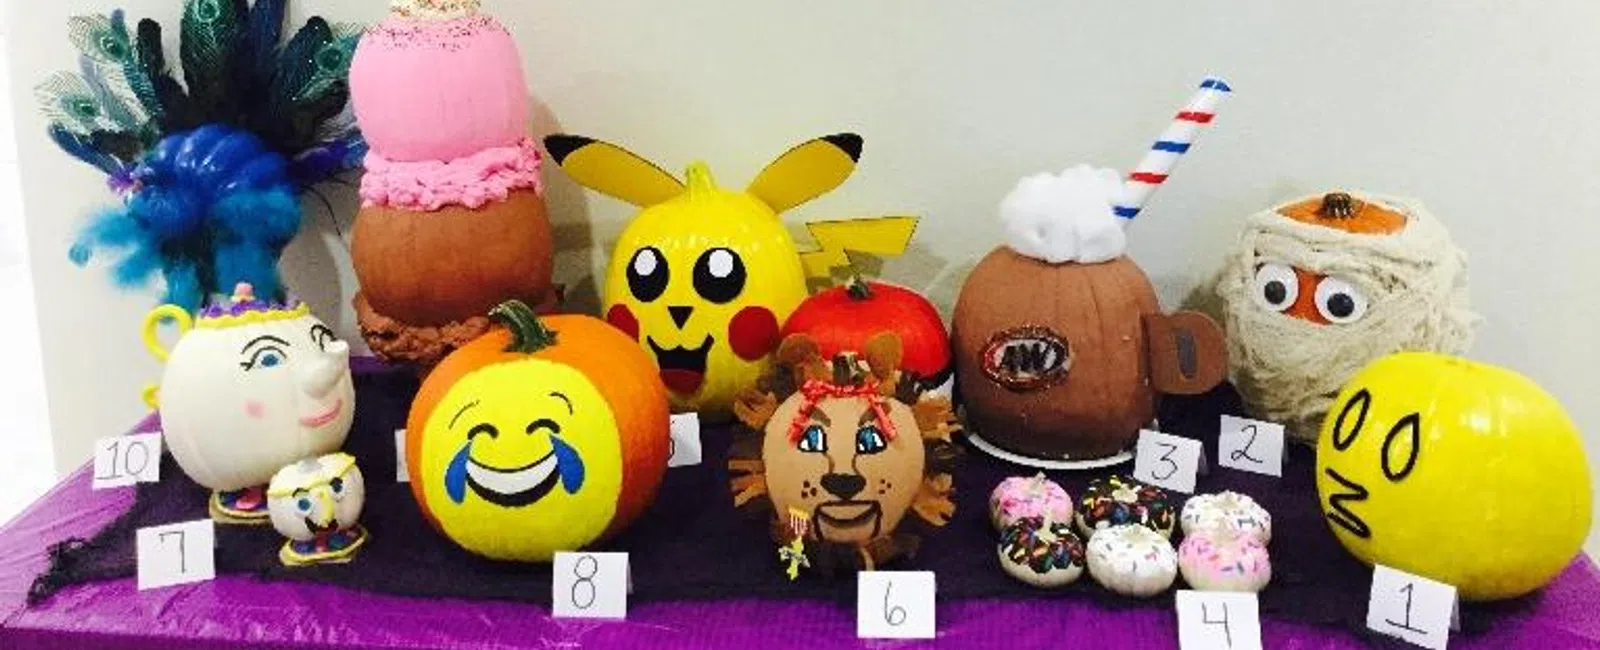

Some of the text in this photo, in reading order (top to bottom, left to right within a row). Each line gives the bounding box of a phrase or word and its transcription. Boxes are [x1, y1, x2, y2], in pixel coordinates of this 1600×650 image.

[96, 442, 149, 480] 10
[1151, 442, 1178, 480] 3
[1231, 425, 1263, 463] 2
[159, 530, 185, 574] 7
[571, 555, 598, 609] 8
[884, 580, 907, 626] 6
[1201, 602, 1232, 649] 4
[1385, 583, 1428, 634] 1
